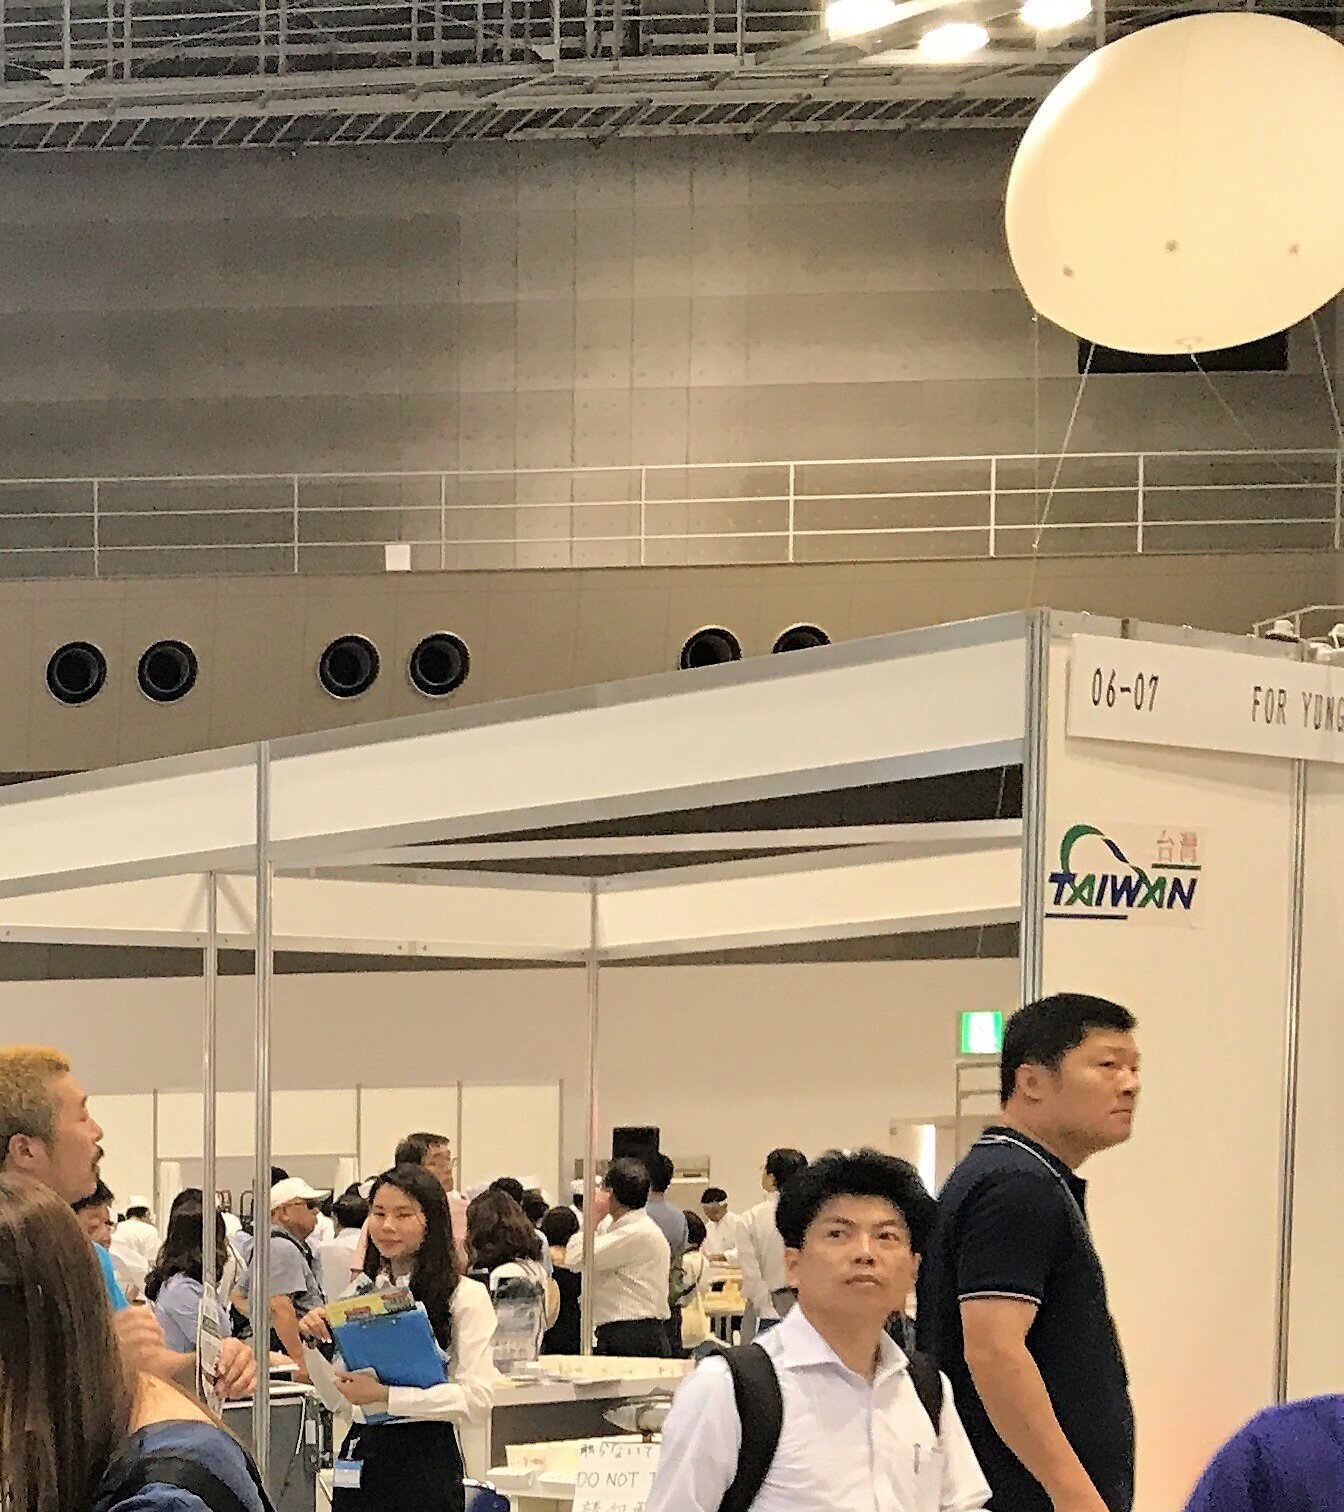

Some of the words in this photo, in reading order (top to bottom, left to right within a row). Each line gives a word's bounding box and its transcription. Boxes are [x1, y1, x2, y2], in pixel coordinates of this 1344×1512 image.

[1091, 668, 1159, 712] 06-07
[1252, 686, 1287, 725] FOR
[1049, 872, 1197, 909] TAIWAN
[577, 1471, 599, 1488] DO
[607, 1471, 639, 1488] NOT
